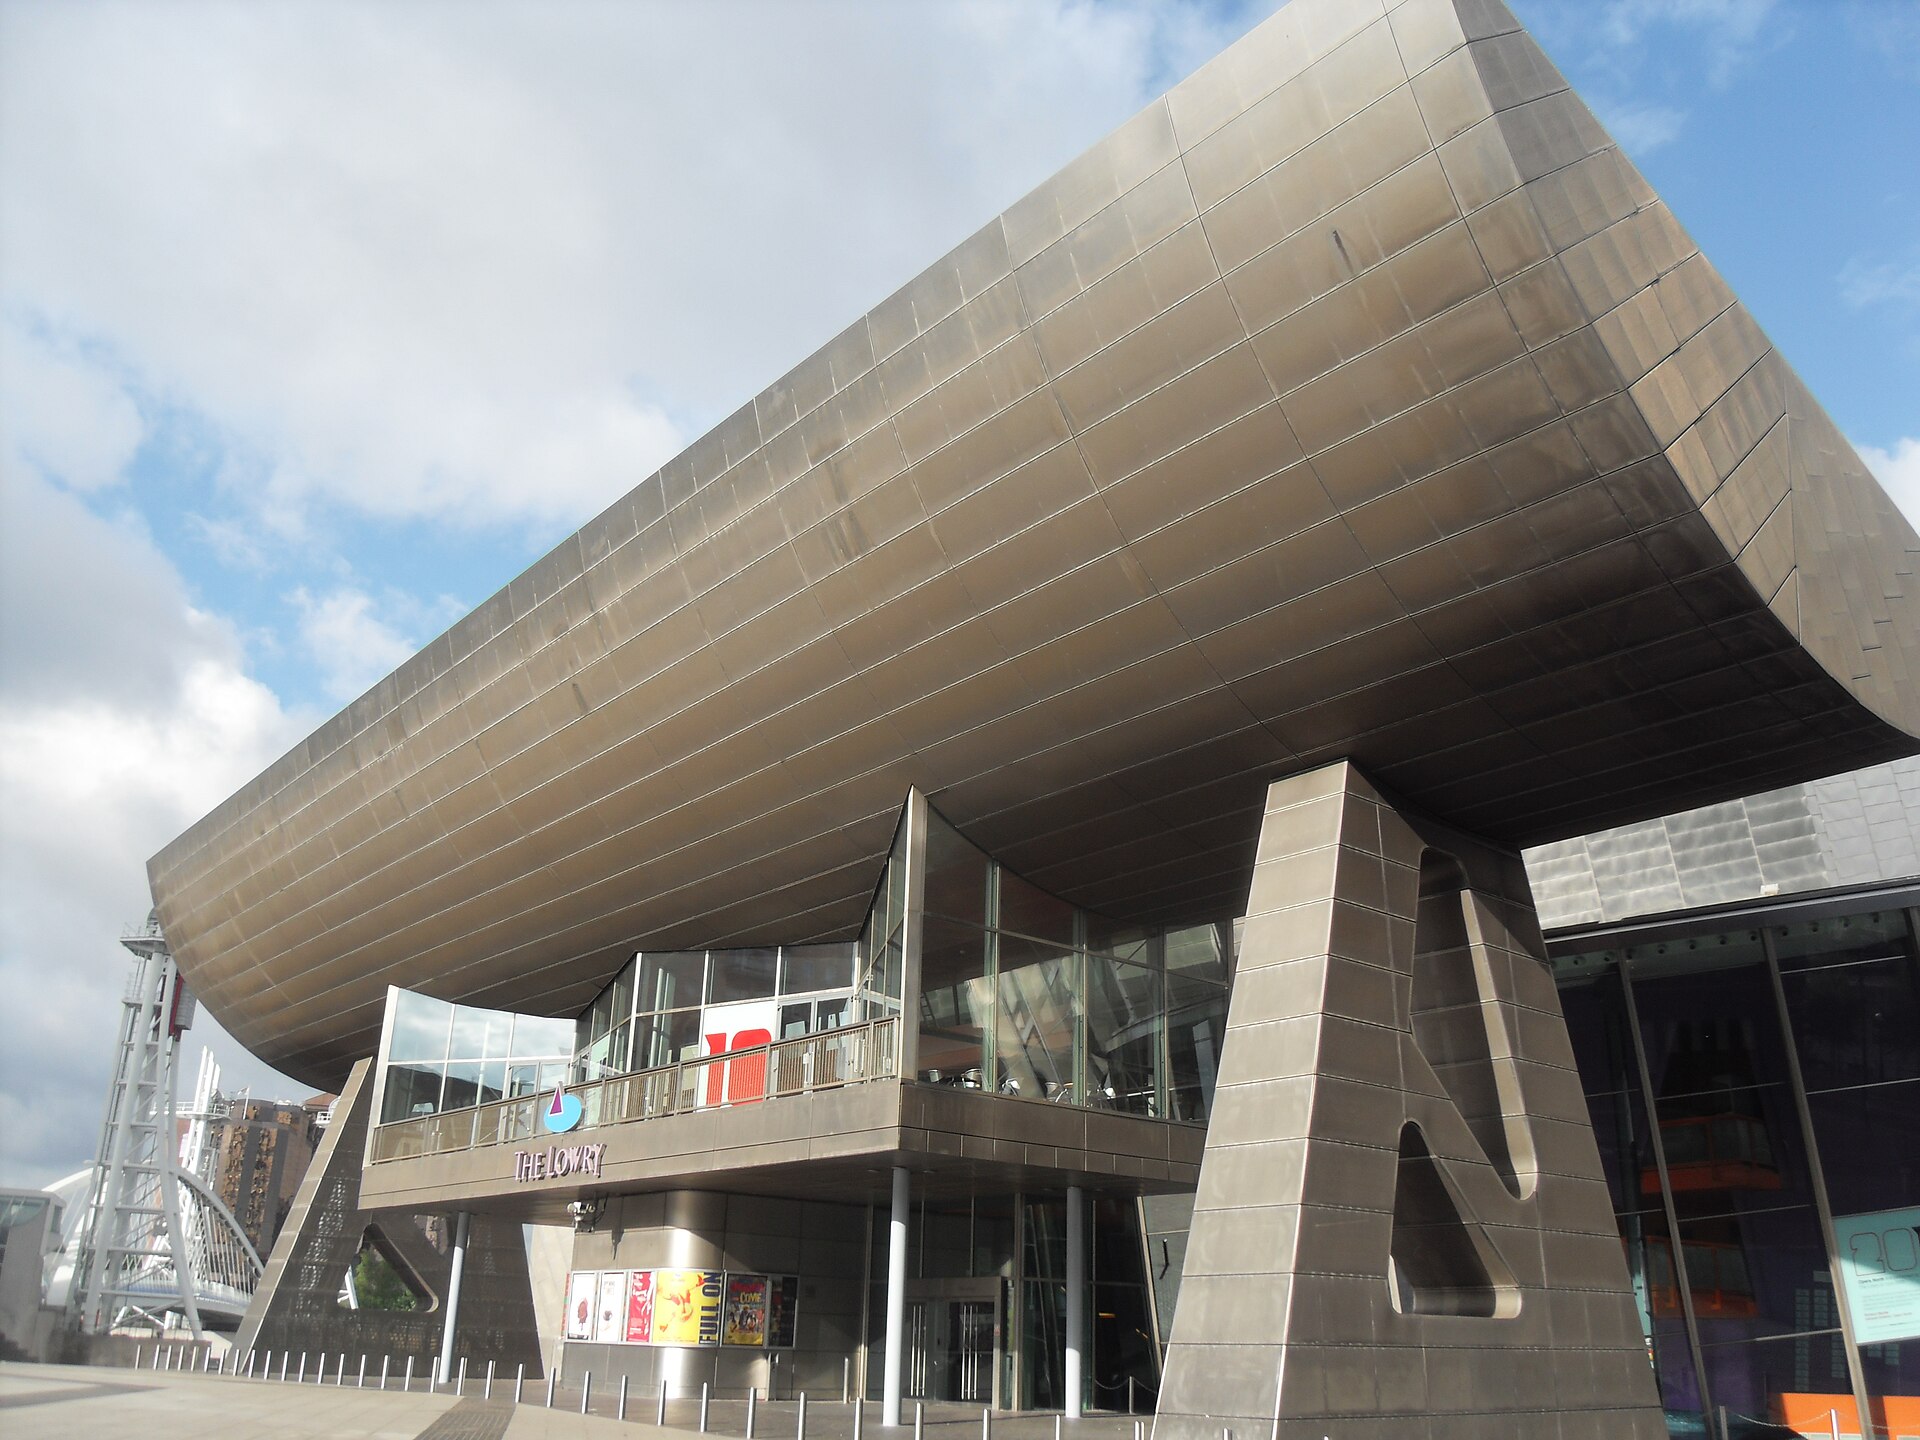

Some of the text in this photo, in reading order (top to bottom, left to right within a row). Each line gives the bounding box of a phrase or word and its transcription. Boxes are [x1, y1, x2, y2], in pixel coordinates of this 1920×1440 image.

[705, 1028, 772, 1107] 10
[515, 1143, 606, 1181] THE LOWRY
[1849, 1226, 1920, 1276] 20
[699, 1272, 721, 1344] FULL ON
